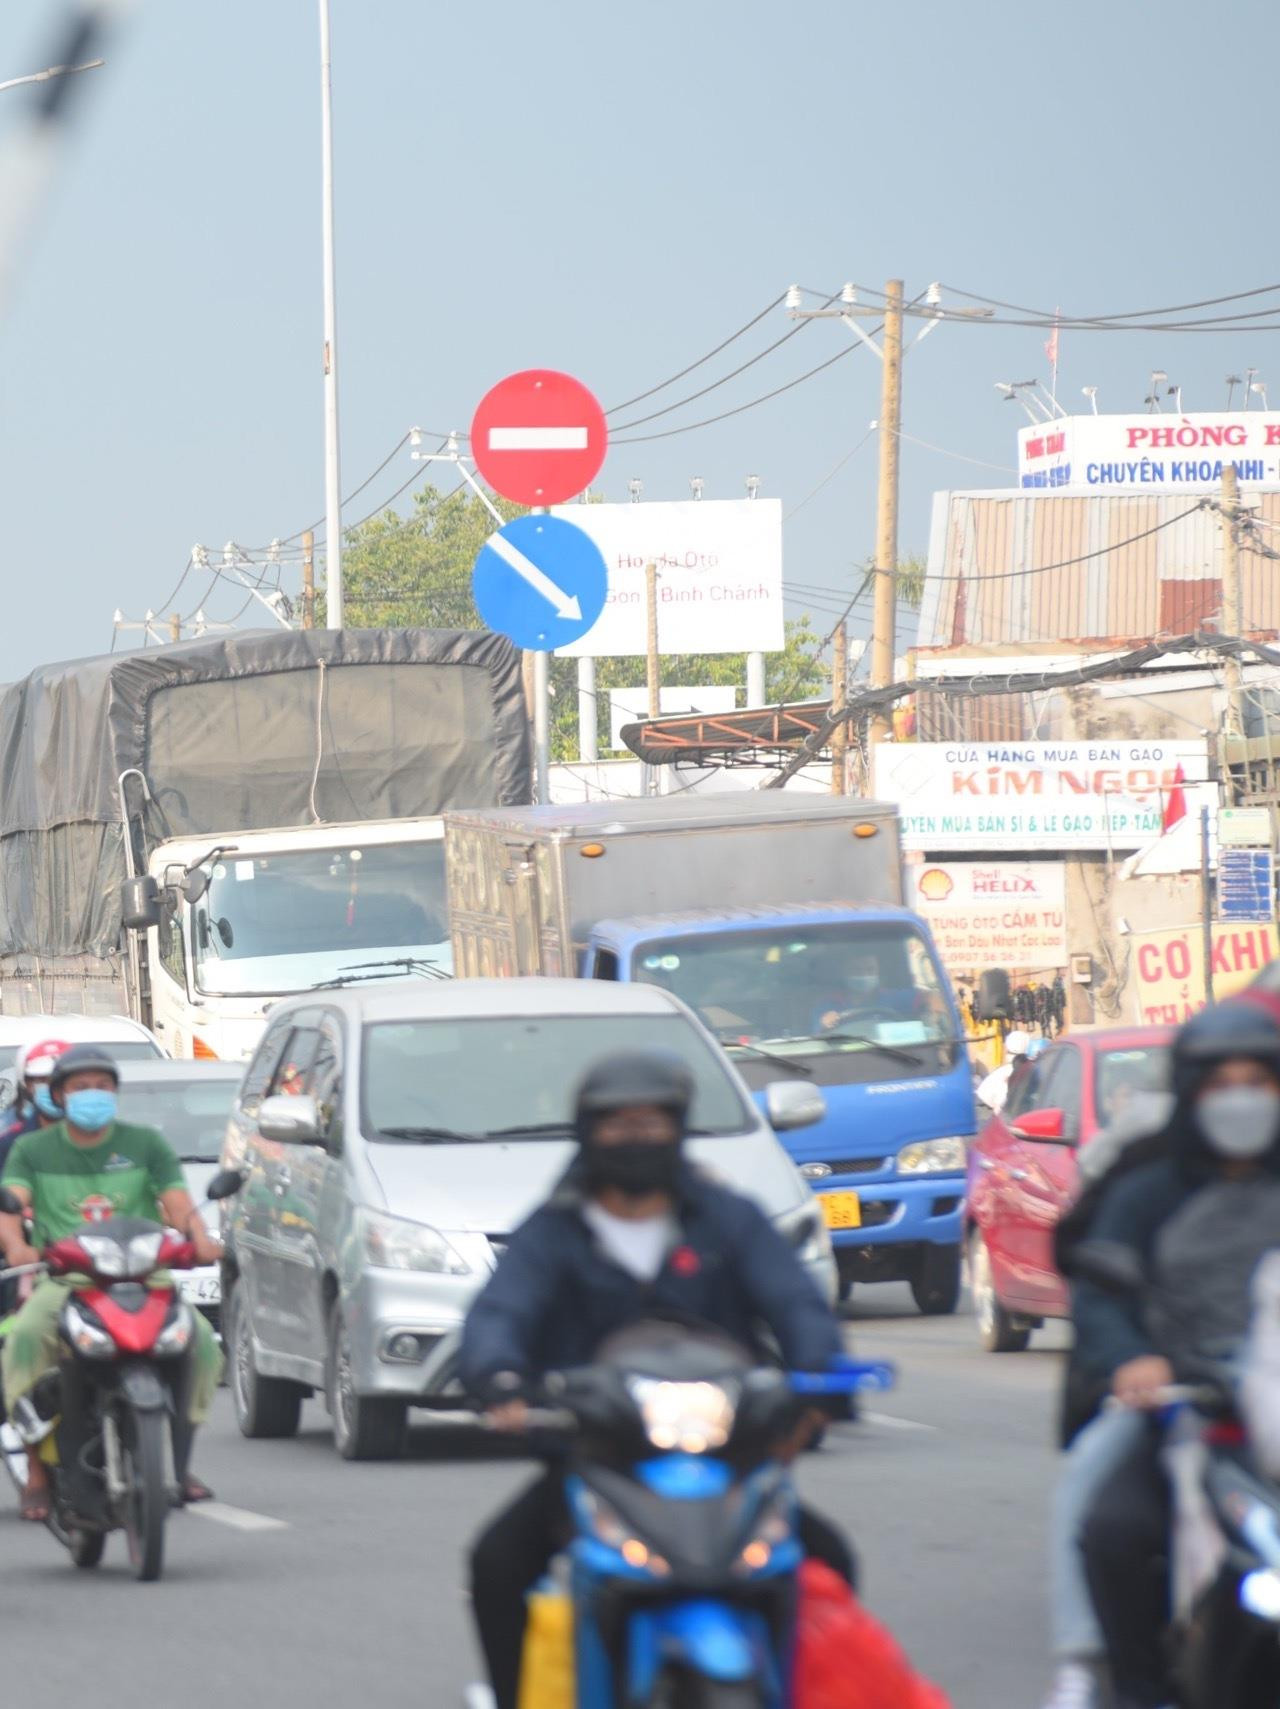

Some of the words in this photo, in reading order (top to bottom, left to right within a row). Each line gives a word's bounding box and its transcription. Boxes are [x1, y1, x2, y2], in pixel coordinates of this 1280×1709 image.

[1126, 418, 1248, 448] PHÒNG
[1086, 456, 1165, 484] CHUYÊN
[1043, 749, 1078, 762] MUA
[973, 879, 1037, 892] HELIX
